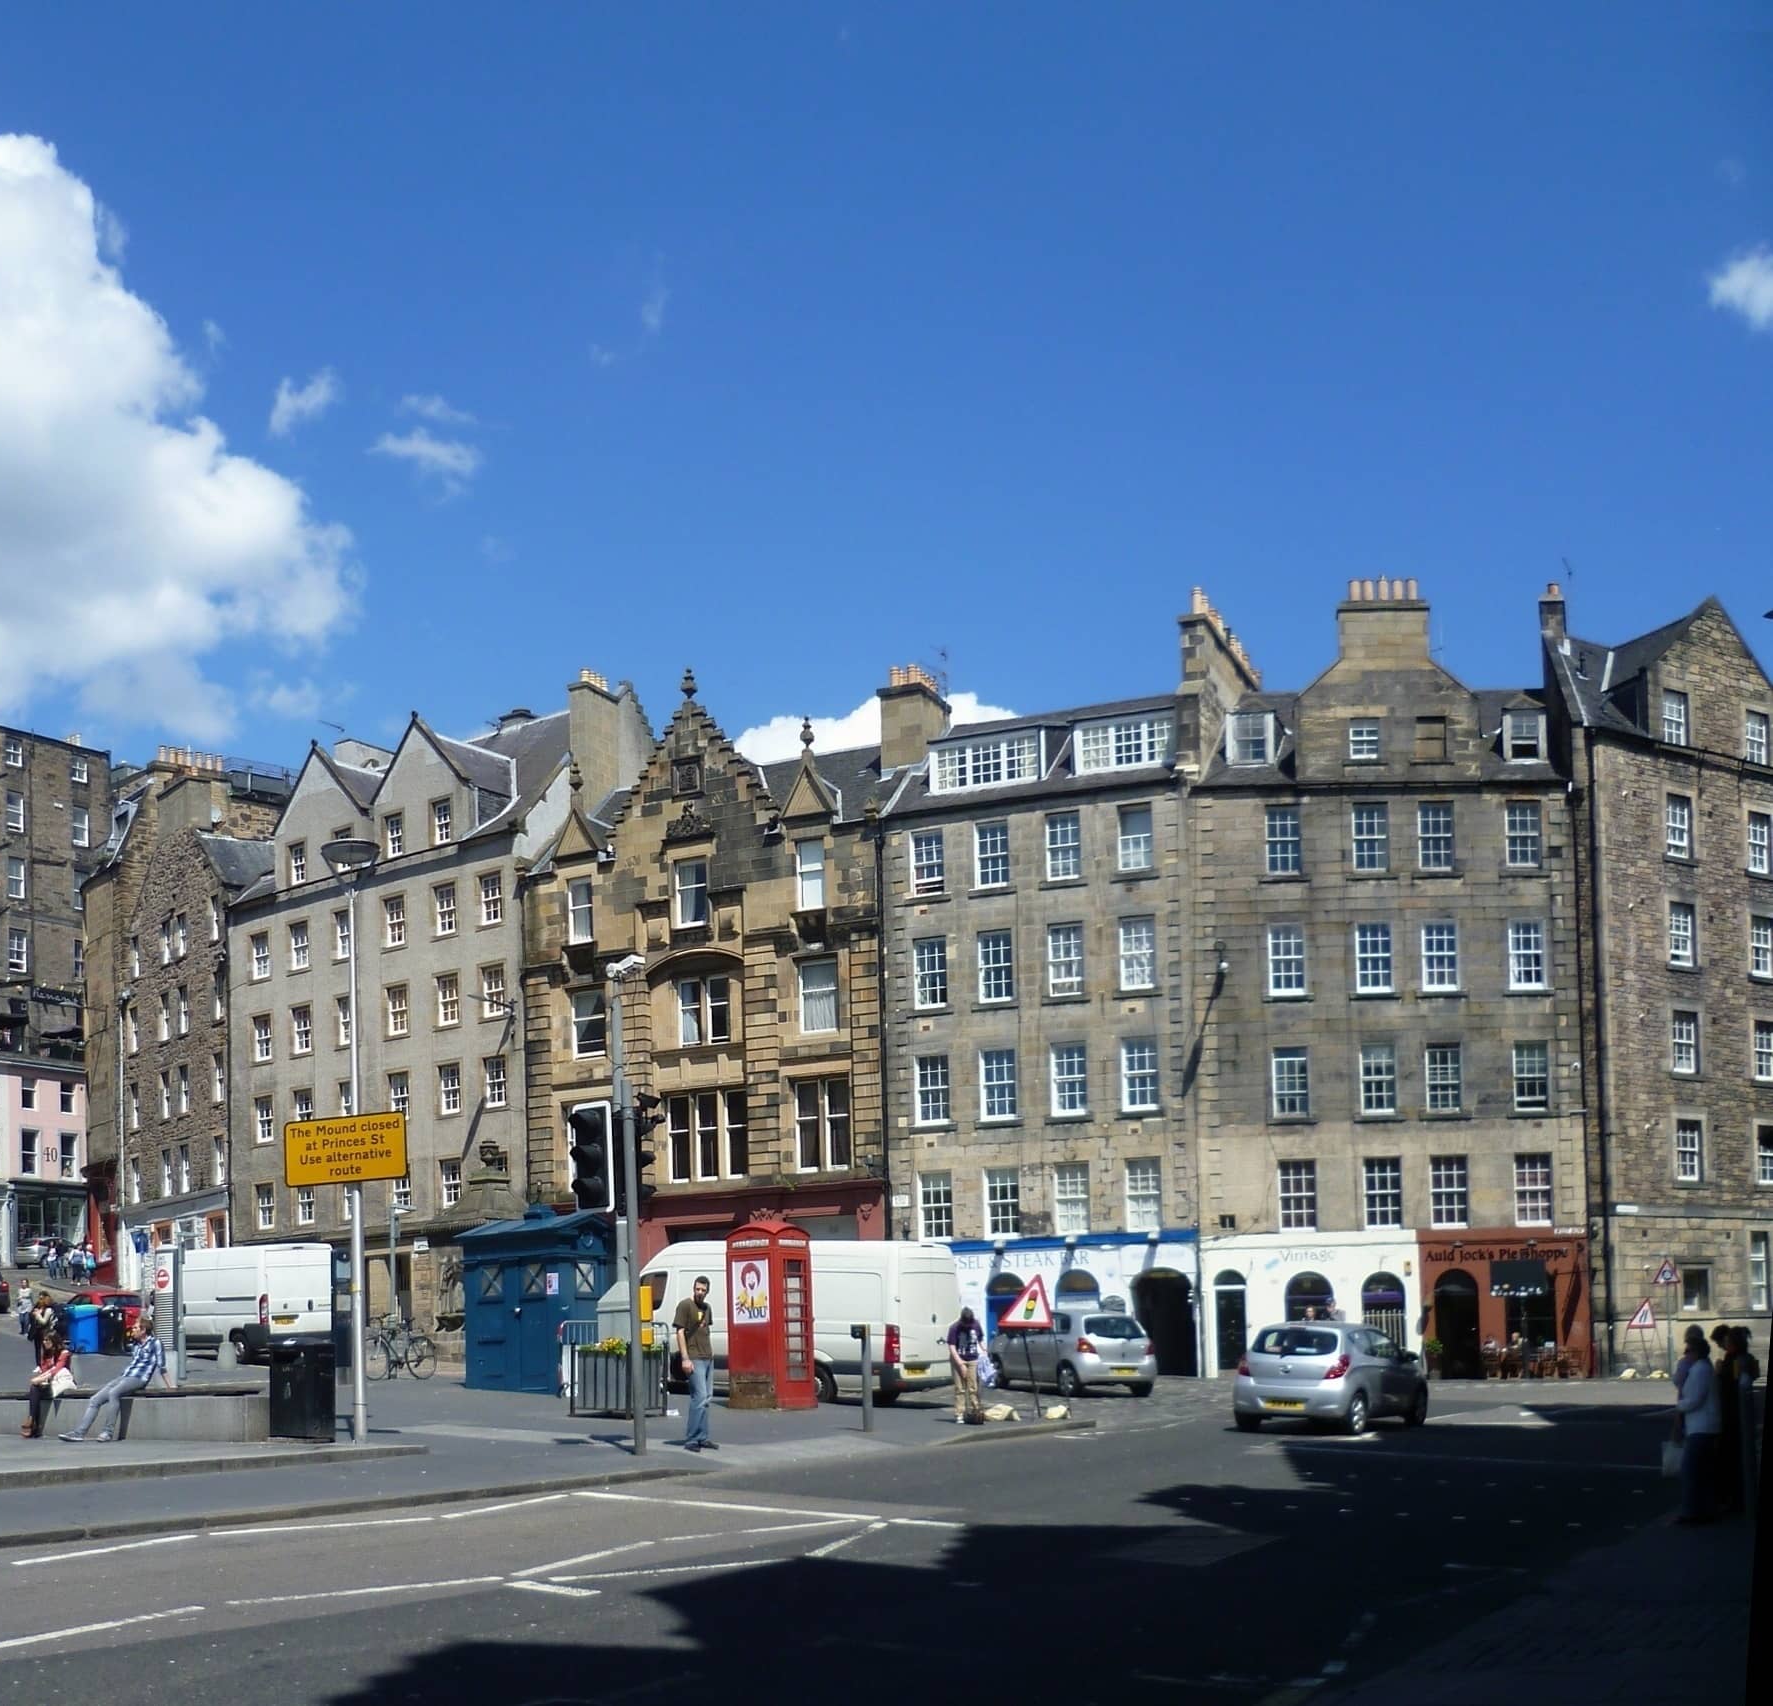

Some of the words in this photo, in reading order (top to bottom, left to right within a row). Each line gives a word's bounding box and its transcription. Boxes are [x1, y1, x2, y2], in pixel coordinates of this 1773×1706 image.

[290, 1127, 312, 1138] The
[316, 1123, 356, 1136] Mound
[361, 1118, 400, 1132] closed
[305, 1141, 318, 1151] at
[322, 1138, 366, 1149] Princes
[371, 1134, 385, 1145] St
[43, 1147, 58, 1162] 40
[300, 1155, 322, 1165] Use
[326, 1148, 392, 1163] alternative
[329, 1165, 362, 1176] route
[956, 1255, 984, 1269] SEL
[989, 1256, 998, 1268] &
[1003, 1252, 1054, 1268] STEAK
[1060, 1250, 1089, 1265] BAR
[1425, 1249, 1455, 1262] Auld
[1499, 1248, 1518, 1260] Pie
[747, 1307, 767, 1319] YOU
